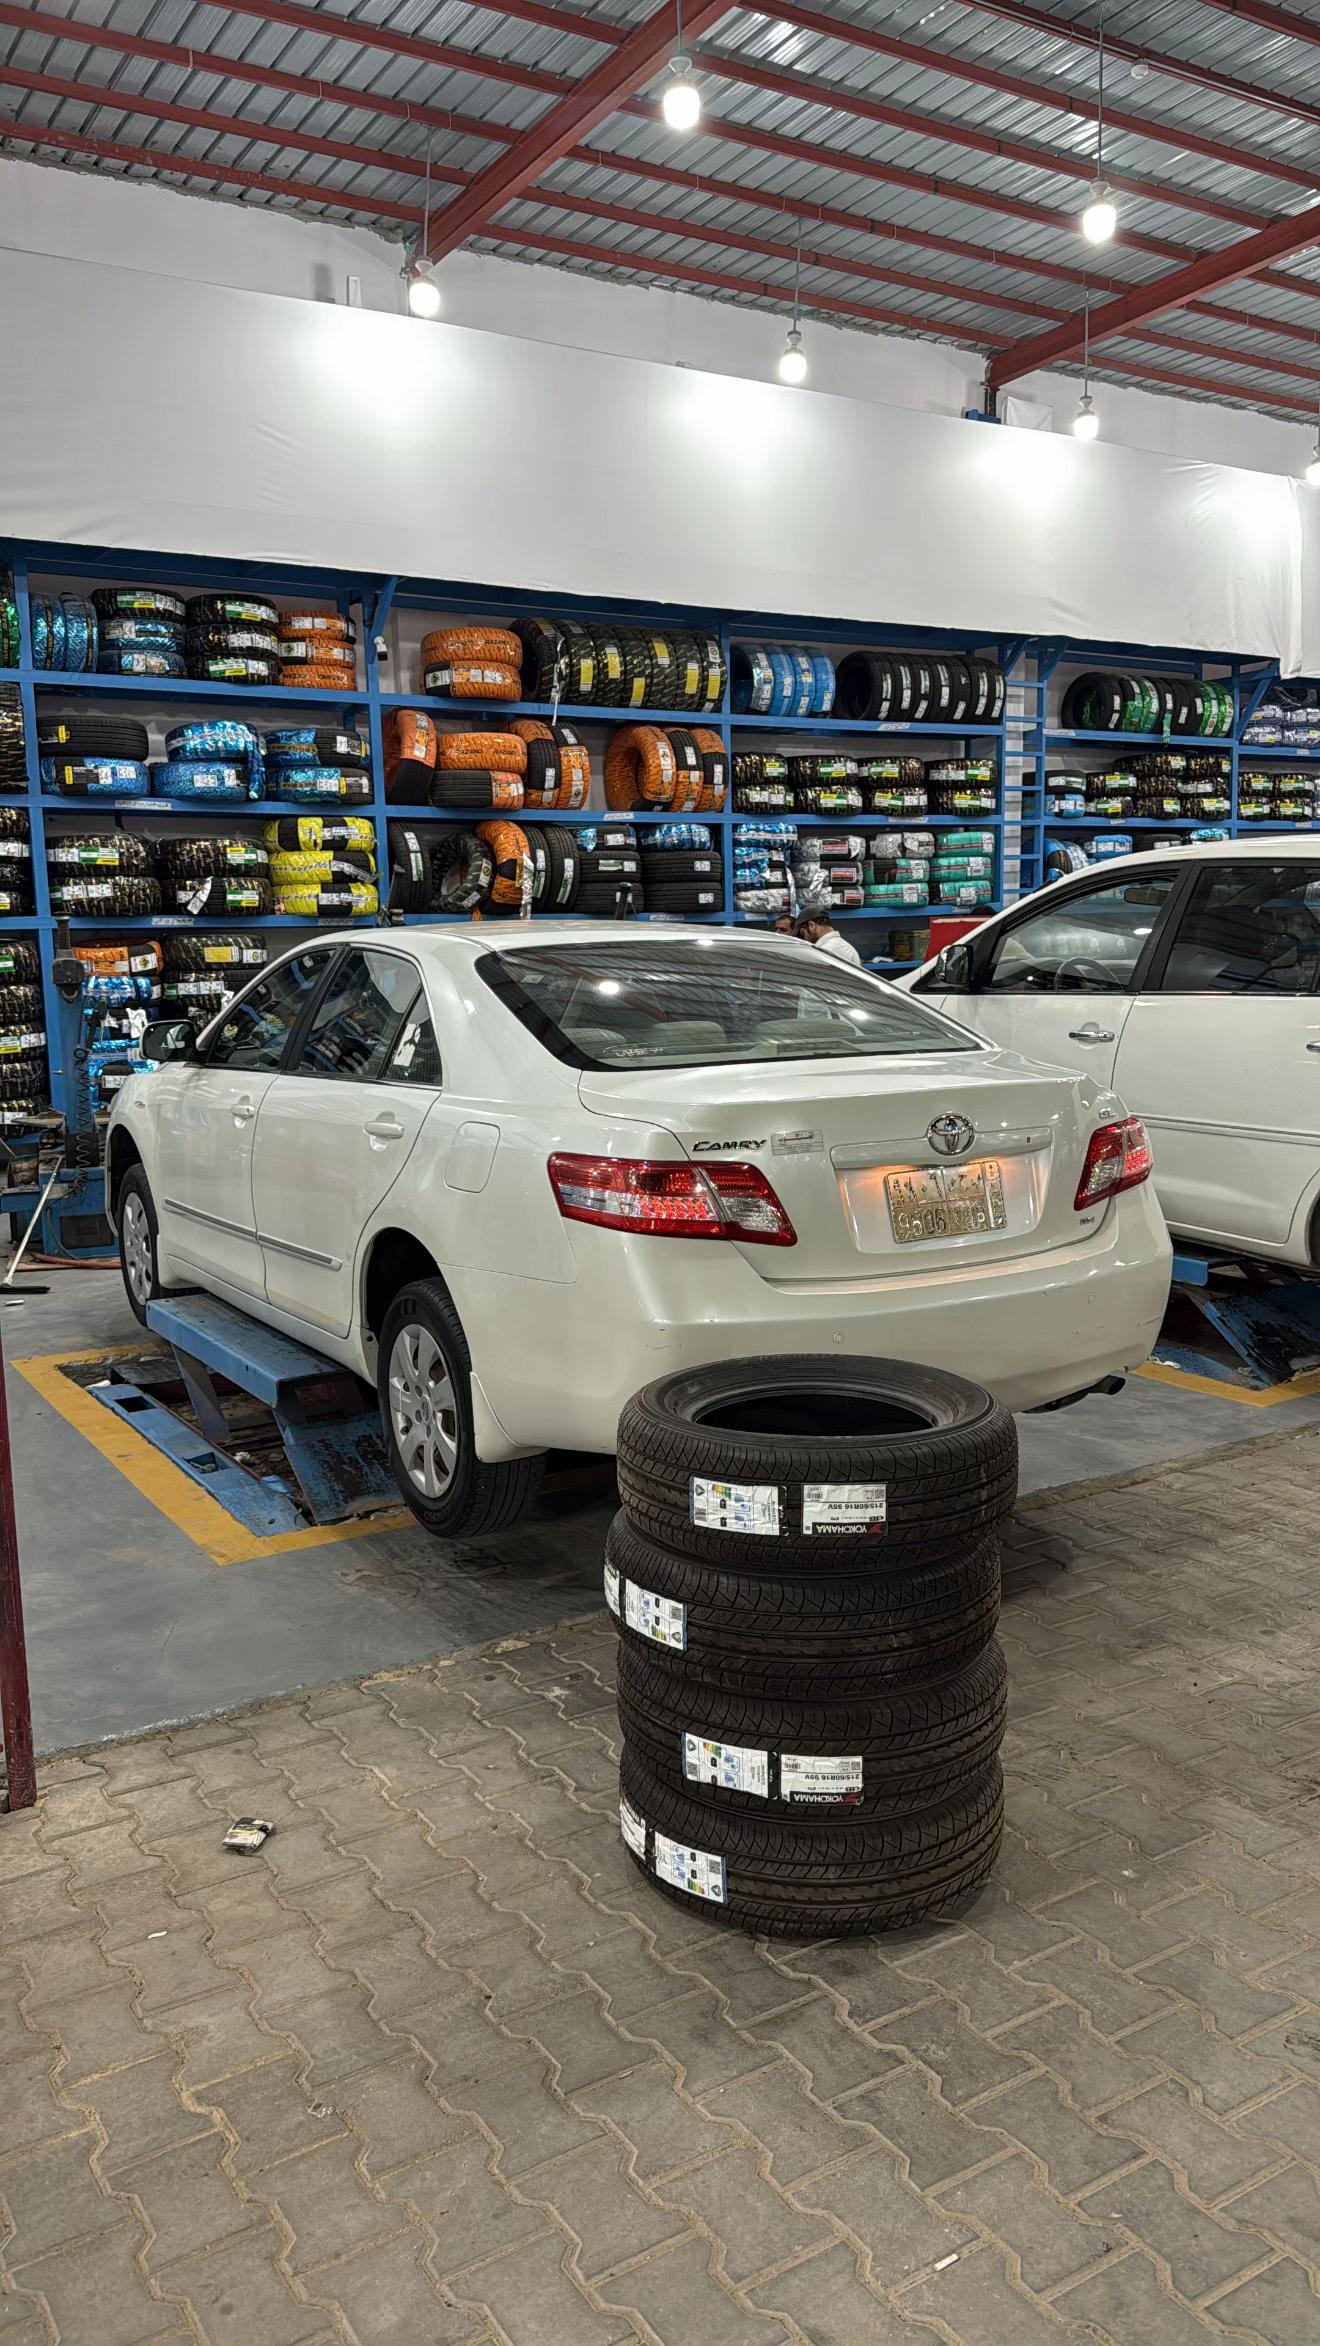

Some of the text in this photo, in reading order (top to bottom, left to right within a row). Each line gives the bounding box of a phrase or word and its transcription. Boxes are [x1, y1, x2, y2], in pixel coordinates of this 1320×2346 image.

[692, 1139, 767, 1152] CAMRY
[816, 1524, 867, 1534] YOKOHAMA
[793, 1794, 844, 1803] YOKOHAMA
